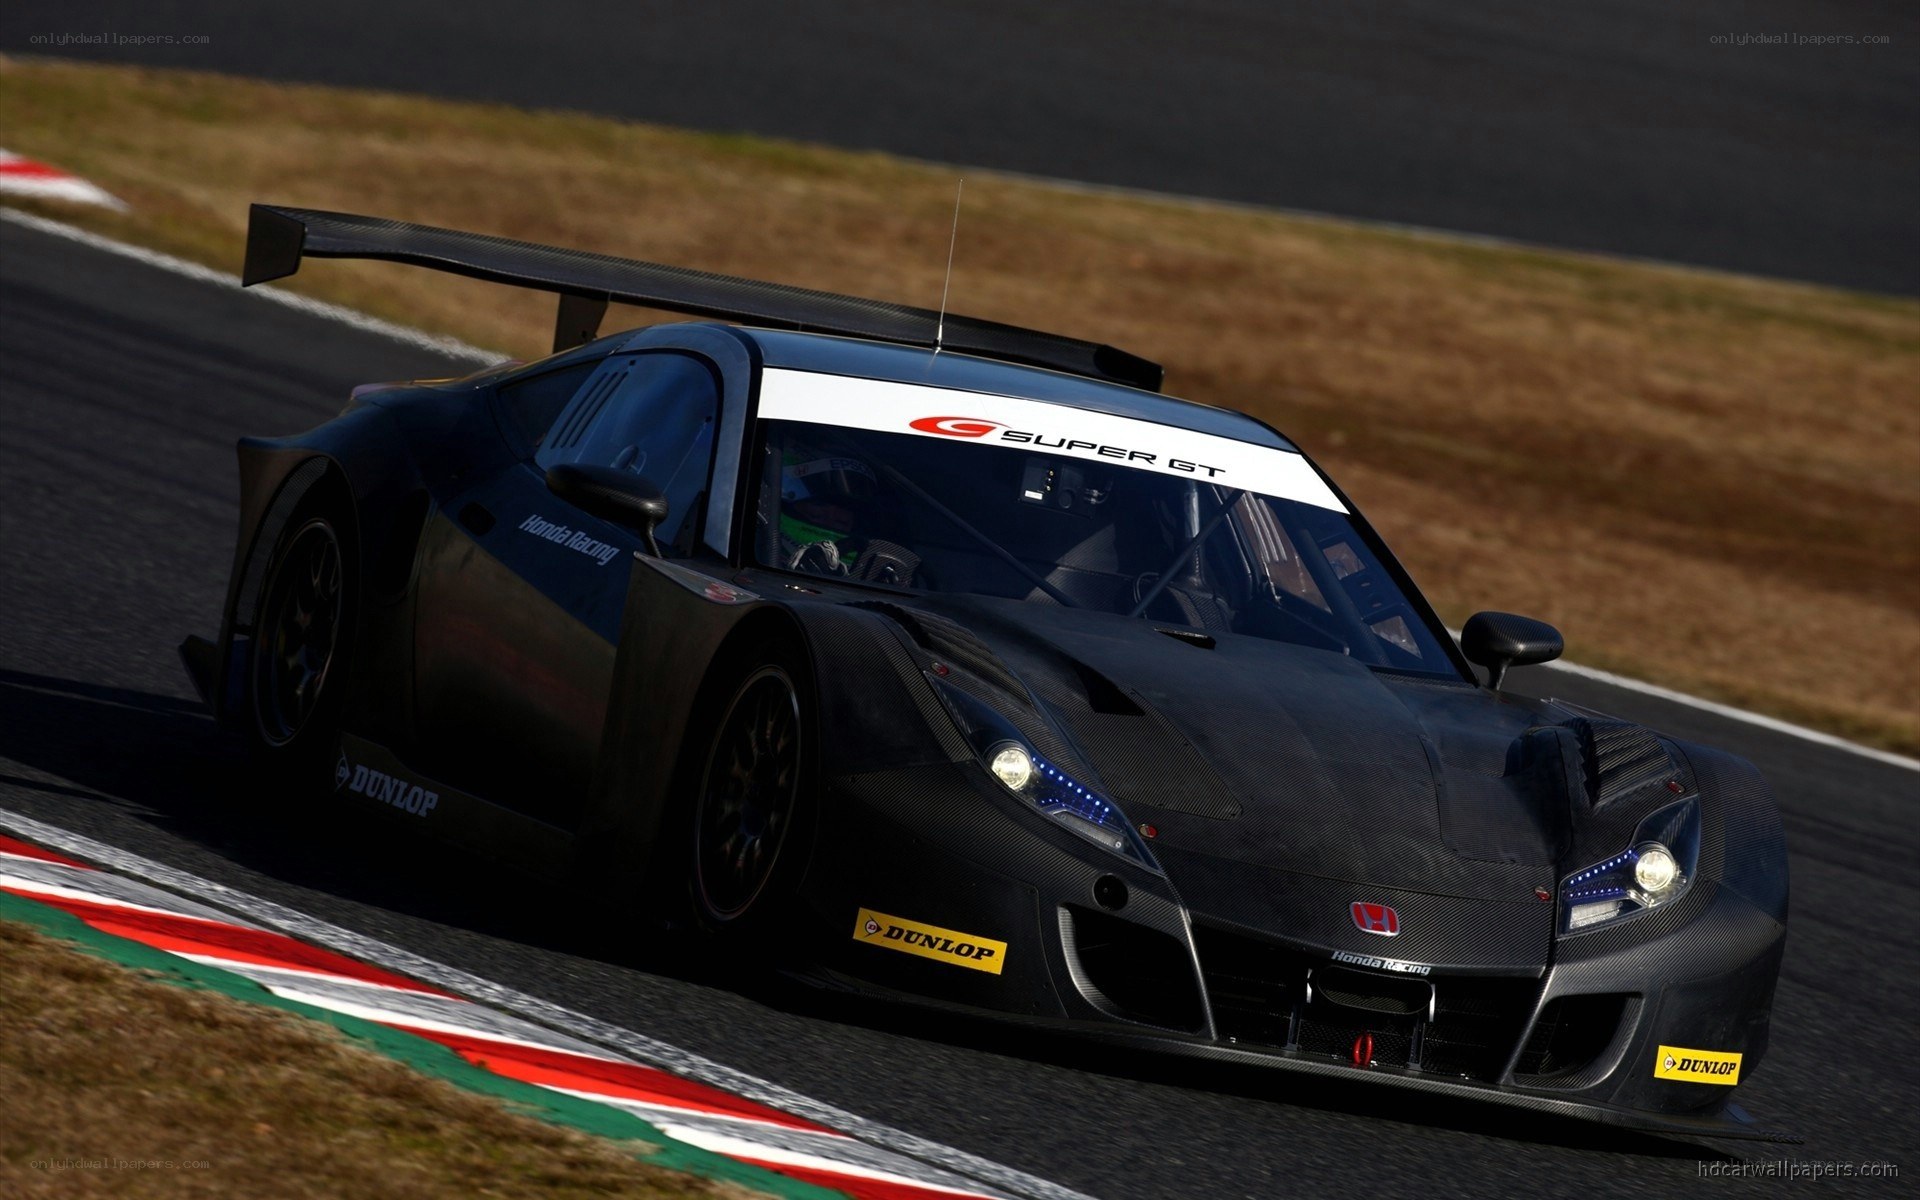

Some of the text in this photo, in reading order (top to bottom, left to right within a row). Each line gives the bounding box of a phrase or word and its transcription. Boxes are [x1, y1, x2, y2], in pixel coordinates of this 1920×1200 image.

[1001, 430, 1226, 478] SUPER GT
[518, 513, 621, 567] Honda Racing
[348, 763, 439, 819] DUNLOP
[883, 925, 995, 960] DUNLOP
[1331, 950, 1432, 976] Honda Racing
[1677, 1058, 1737, 1075] DUNLOP
